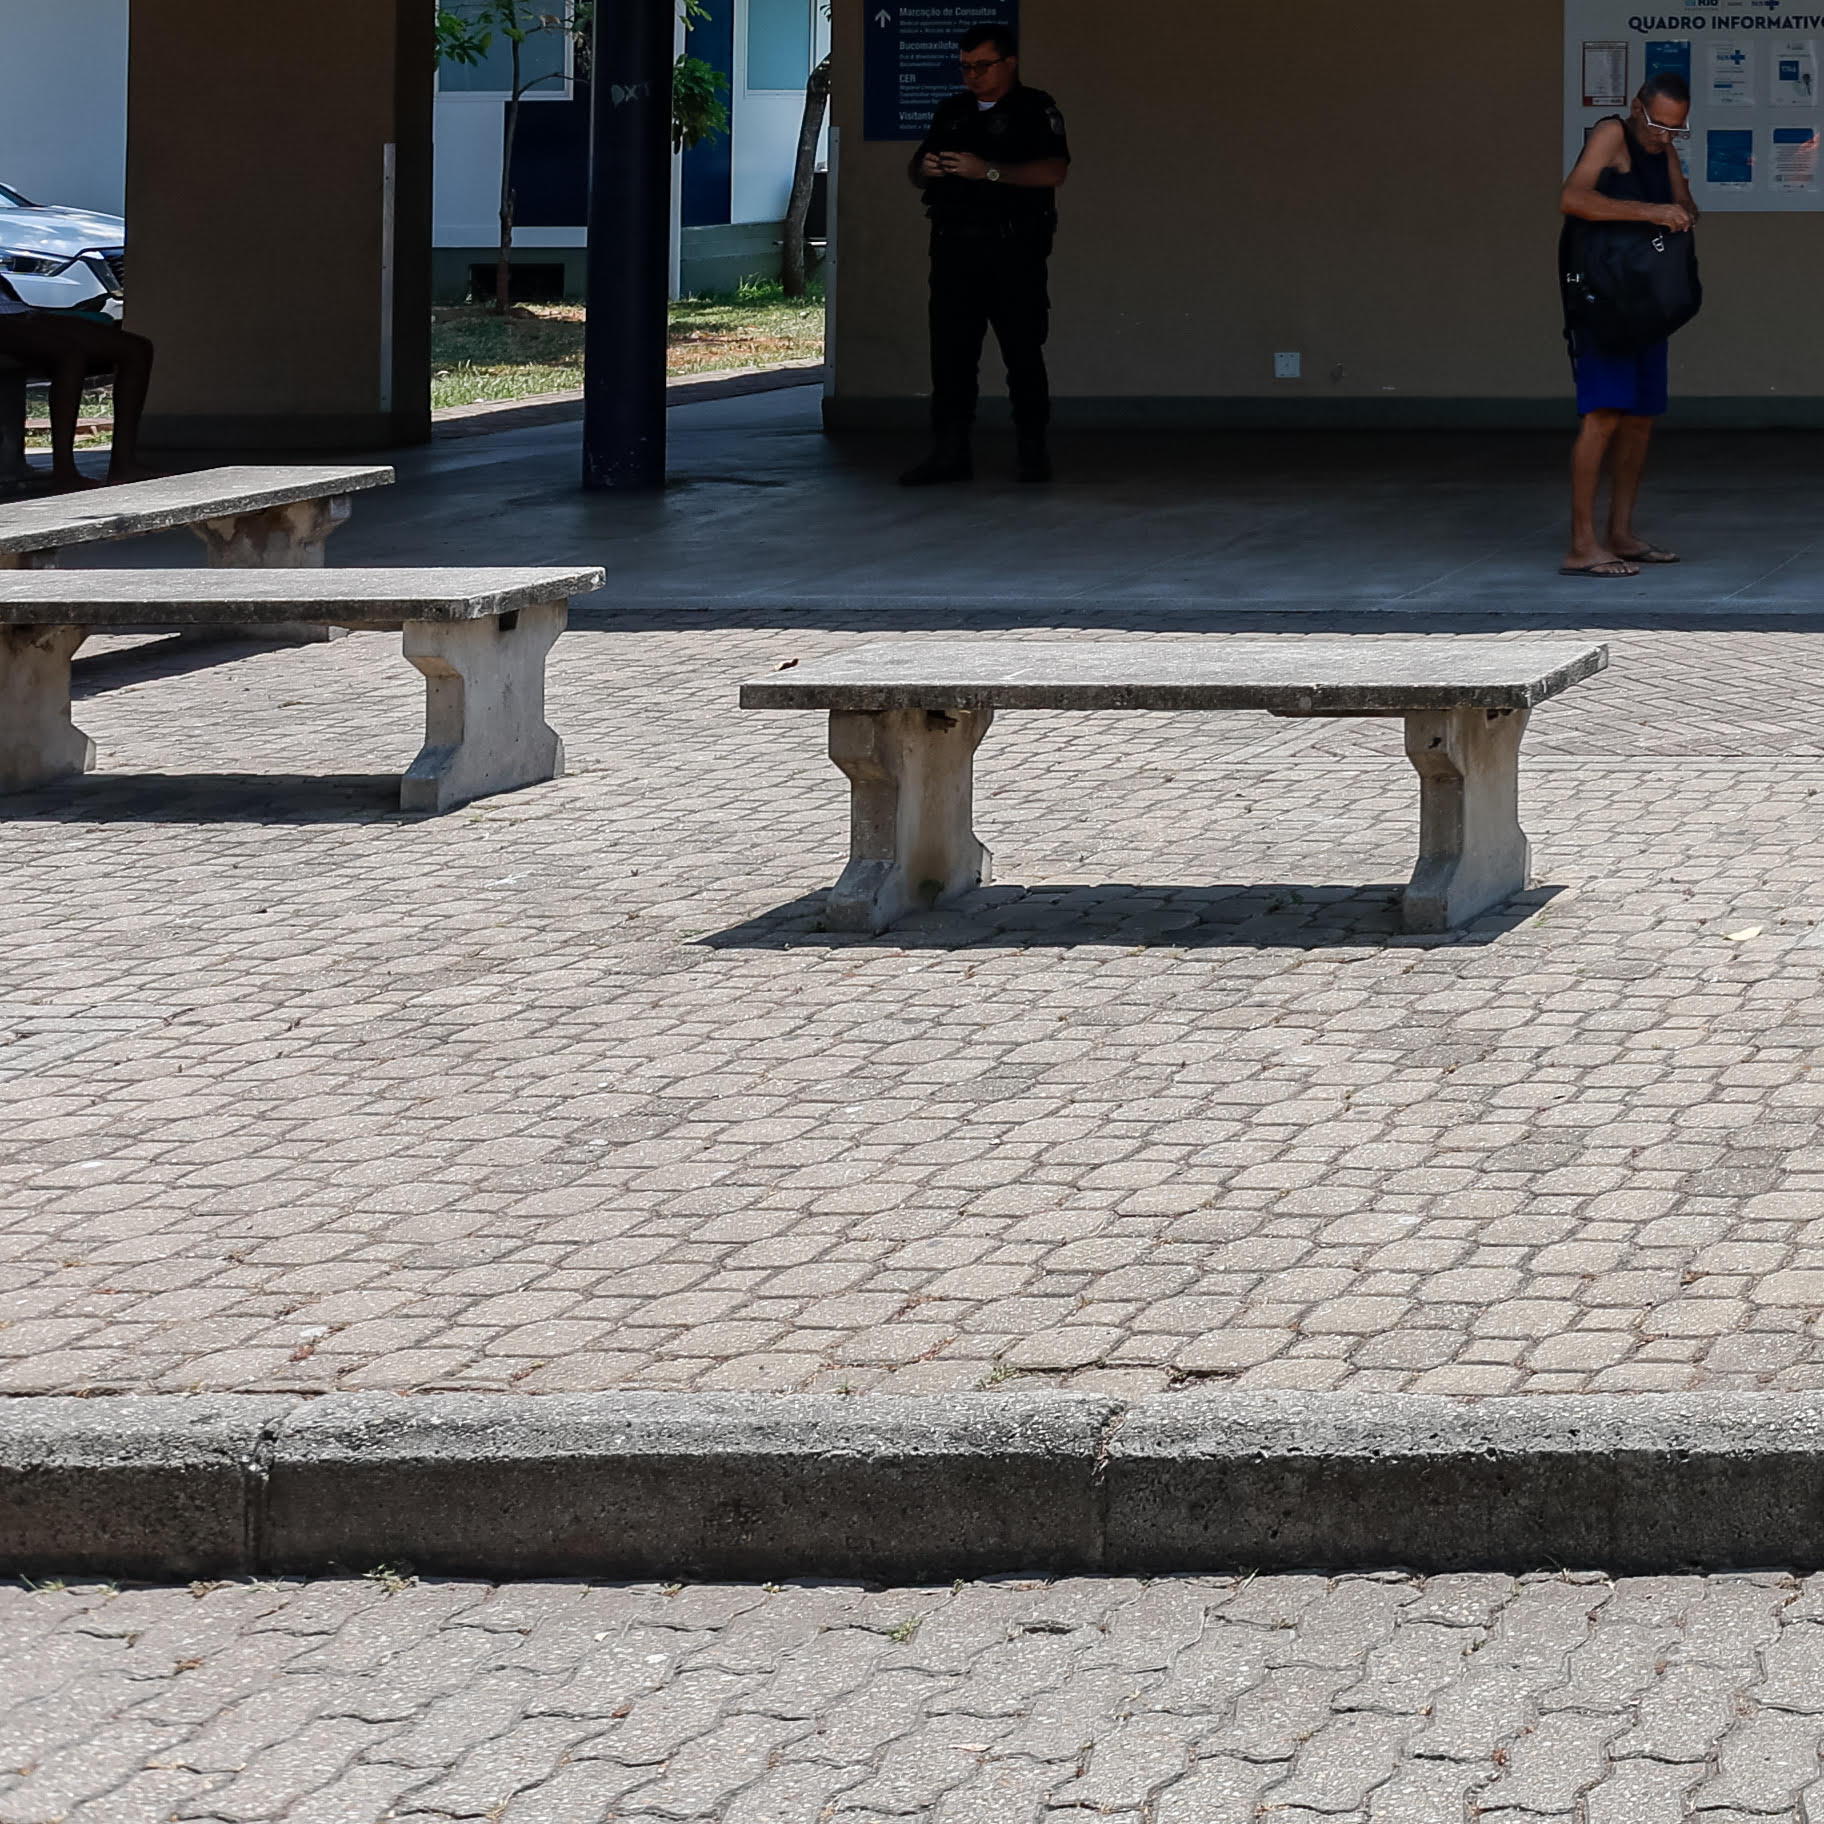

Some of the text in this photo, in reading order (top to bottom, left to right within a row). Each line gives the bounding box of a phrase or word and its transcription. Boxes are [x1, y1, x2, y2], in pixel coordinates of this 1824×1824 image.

[899, 7, 997, 18] Marcação de Consultas
[1628, 16, 1706, 33] QUADRO
